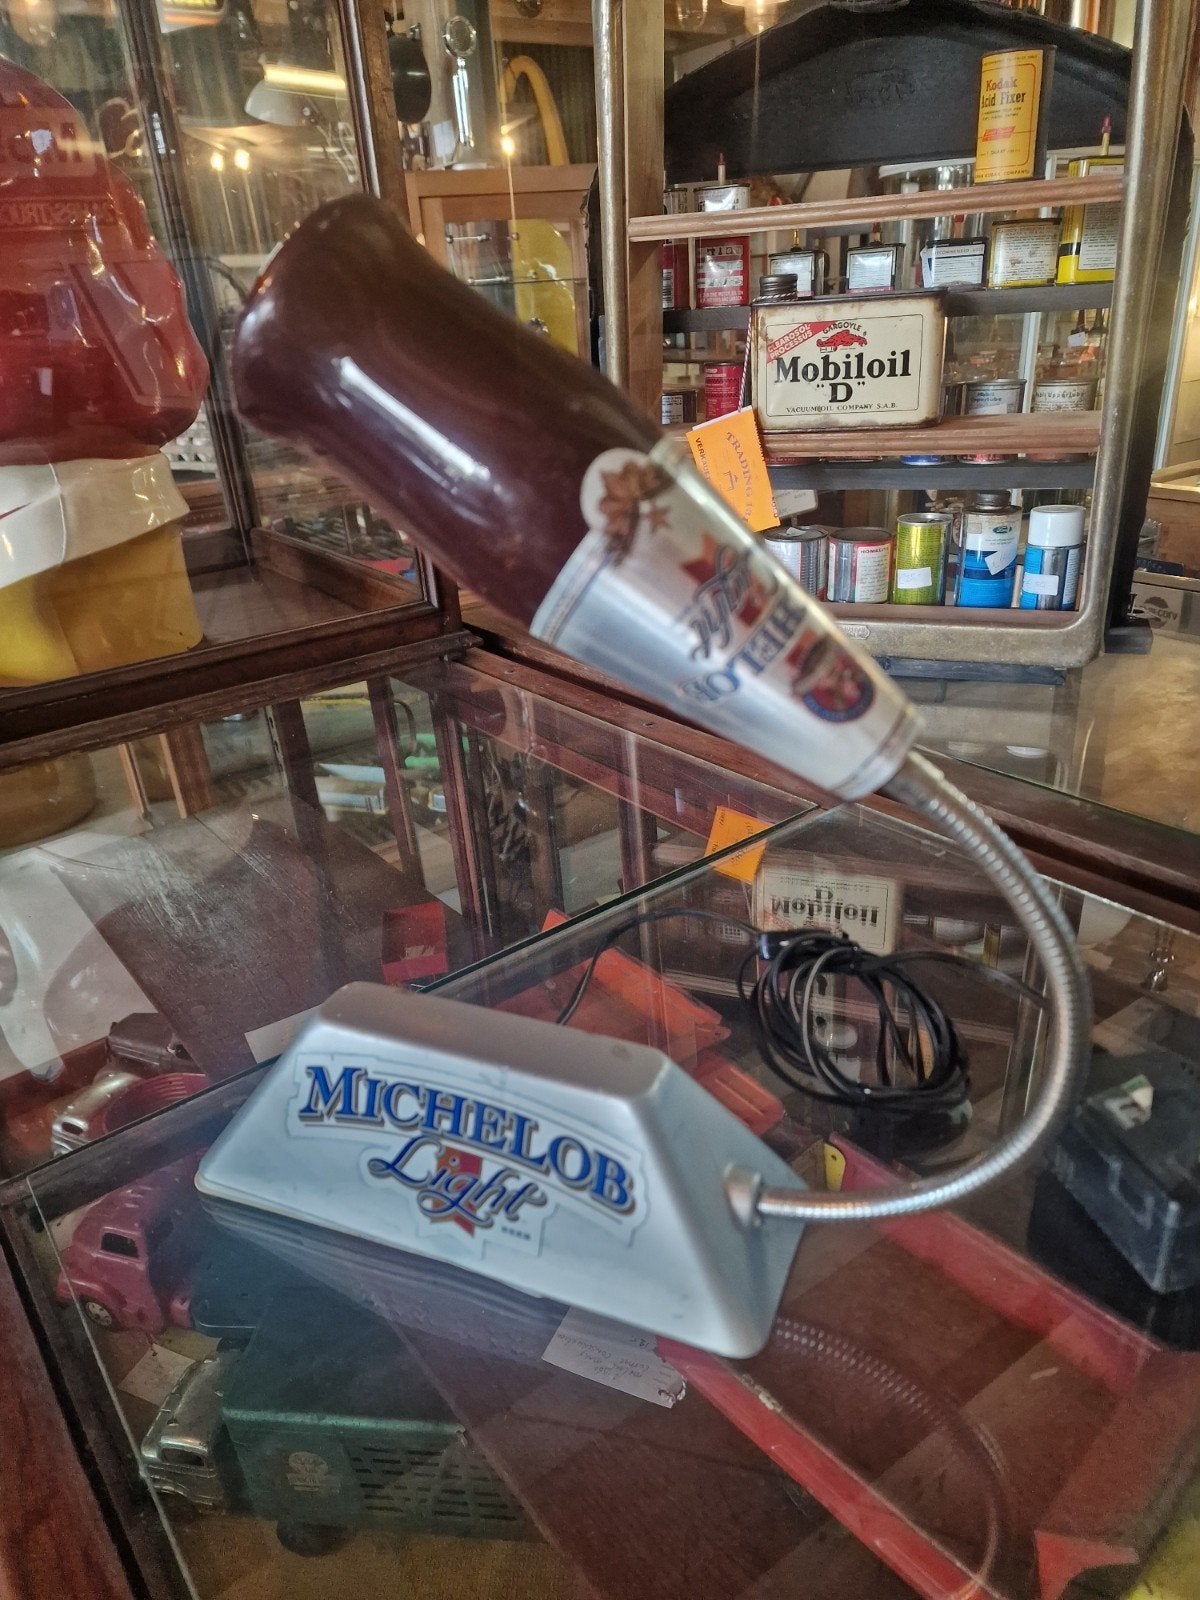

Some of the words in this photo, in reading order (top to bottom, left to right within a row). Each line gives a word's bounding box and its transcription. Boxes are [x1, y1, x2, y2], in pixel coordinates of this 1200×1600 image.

[985, 78, 1018, 92] Kodak
[1000, 92, 1026, 105] Fixer
[822, 321, 862, 334] GARGOYLE
[769, 330, 813, 360] PROCESSUS
[774, 349, 912, 384] Mobiloil
[786, 405, 817, 414] VACUUM
[836, 403, 872, 411] COMPANY
[726, 432, 752, 497] TRADING
[298, 1064, 637, 1216] MICHELOB
[367, 1134, 548, 1230] Light
